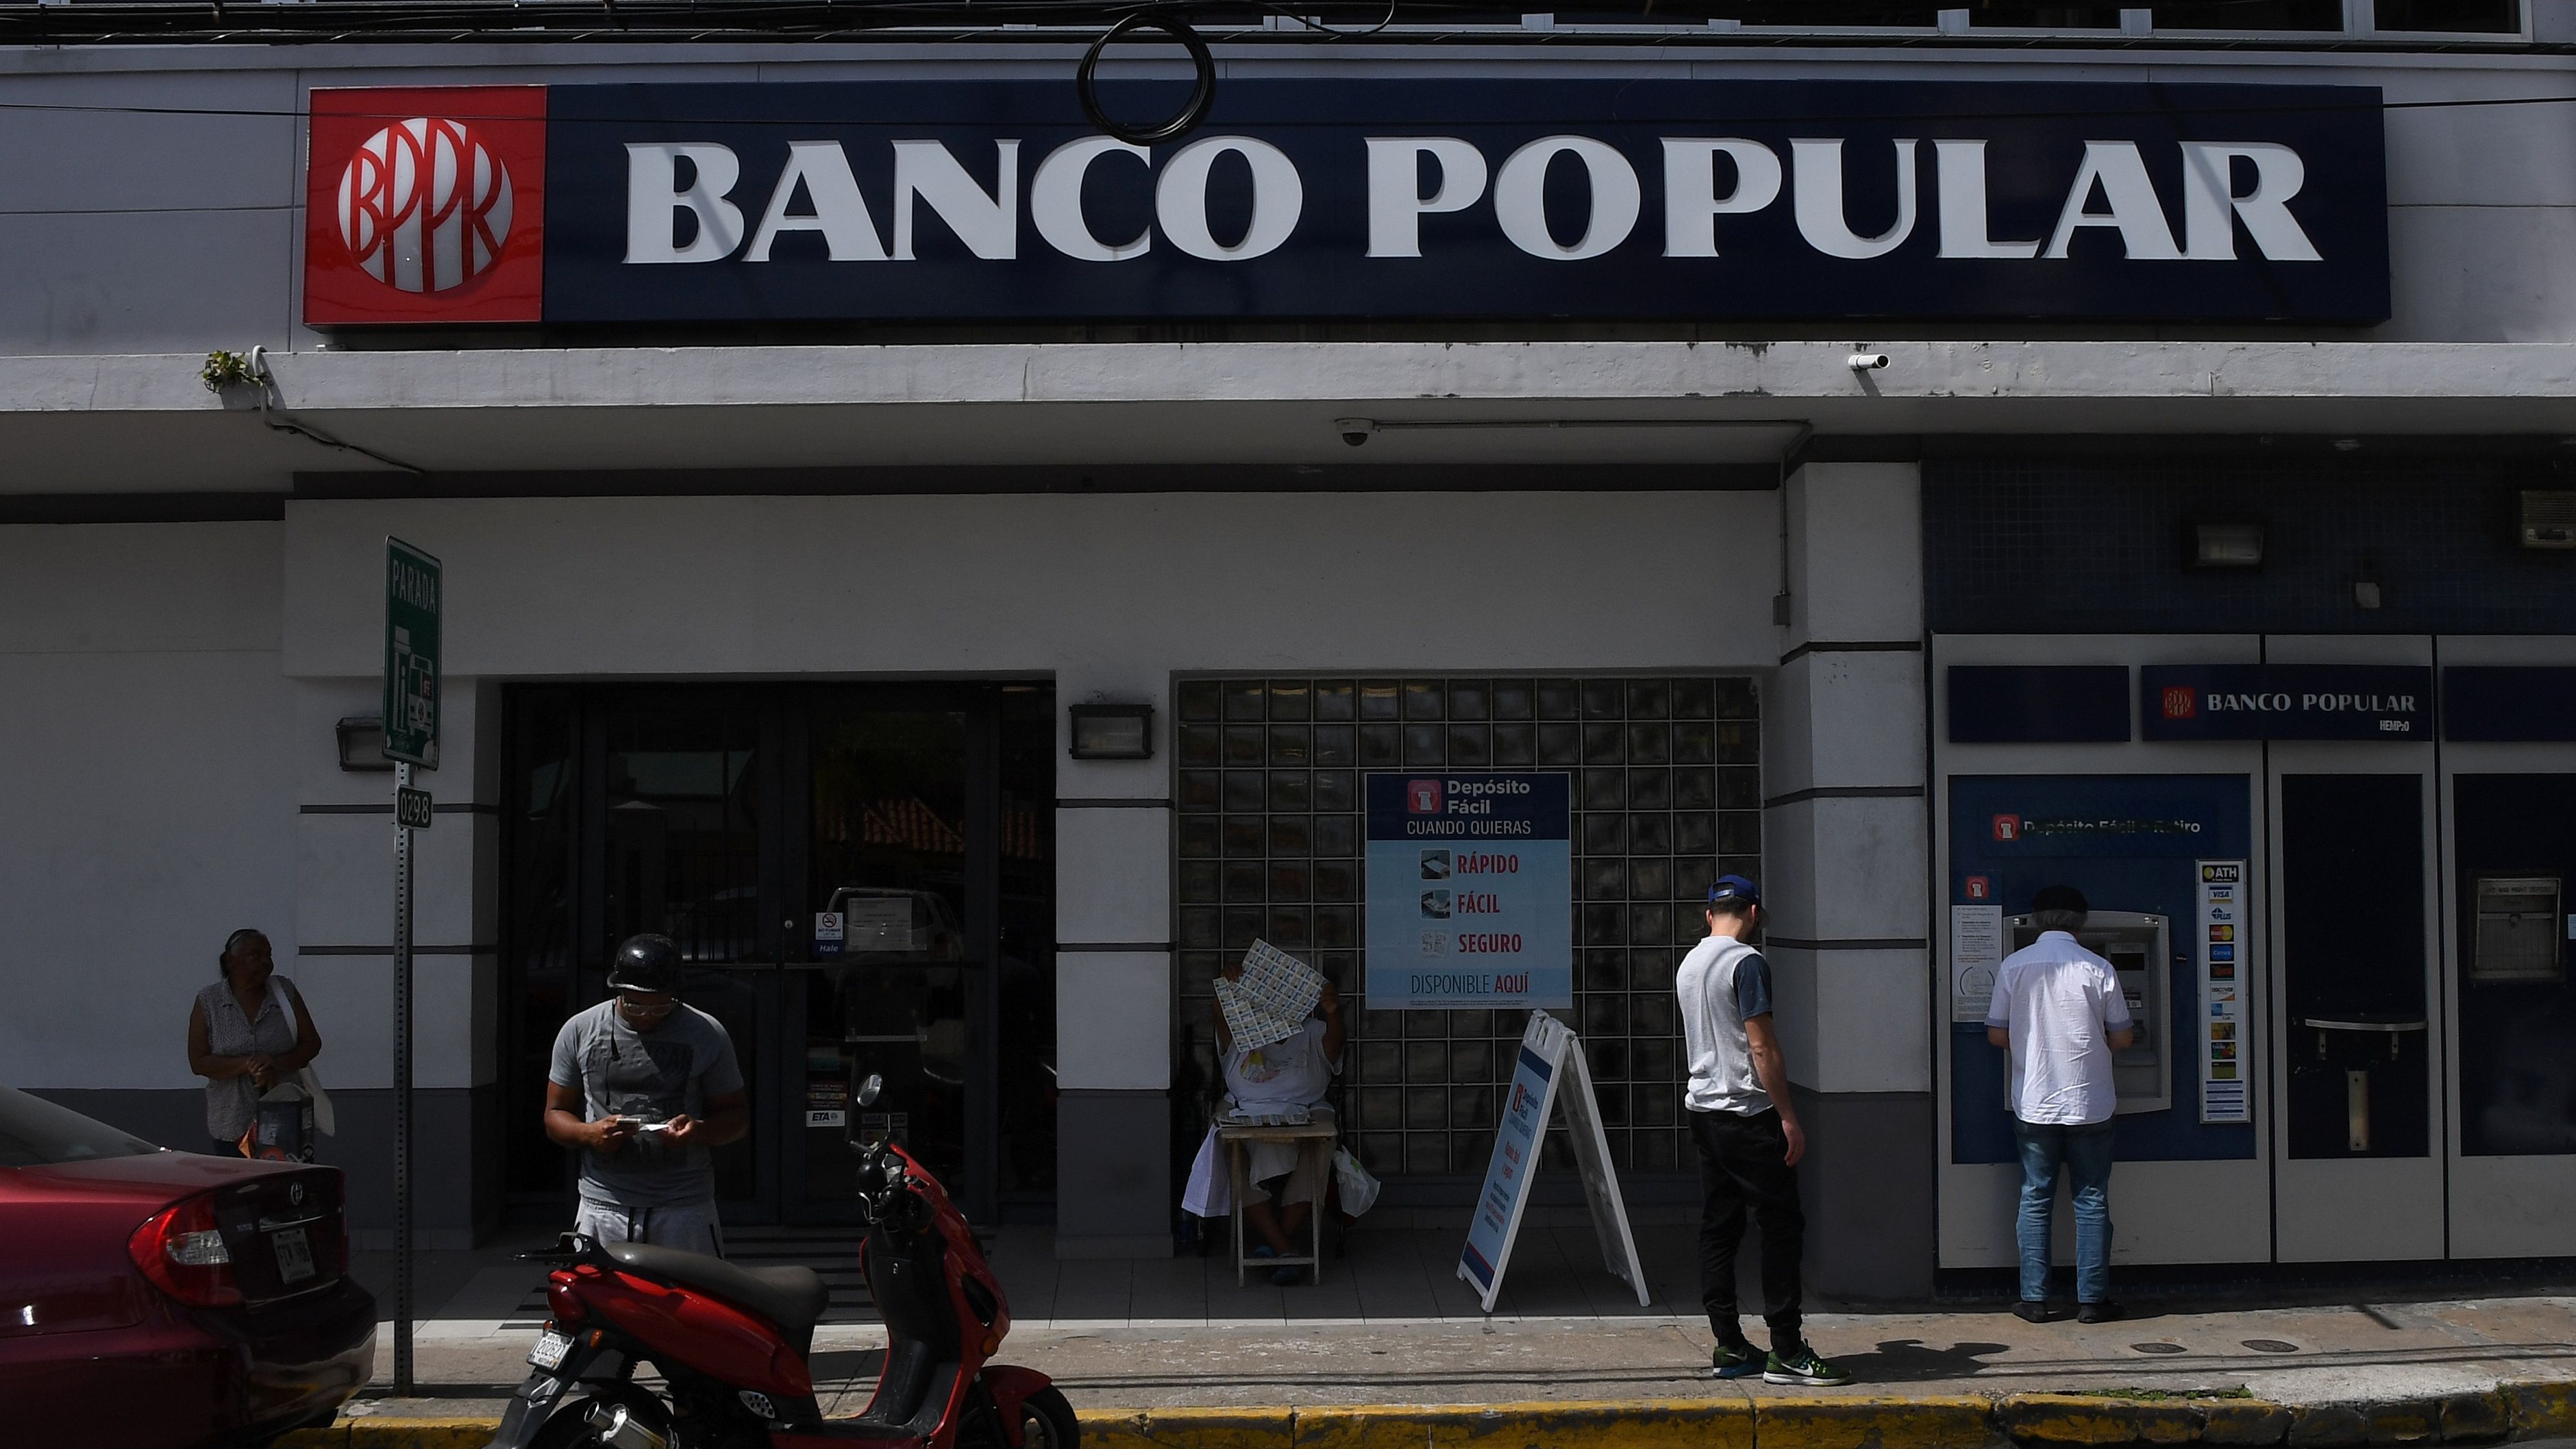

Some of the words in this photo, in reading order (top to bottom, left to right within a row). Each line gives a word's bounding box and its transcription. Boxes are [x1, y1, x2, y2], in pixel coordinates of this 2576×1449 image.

[620, 134, 1304, 264] BANCO
[1363, 134, 2325, 261] POPULAR
[393, 558, 437, 615] PARADA
[2207, 692, 2292, 712] BANCO
[2302, 693, 2416, 713] POPULAR
[1447, 779, 1531, 797] Depósito
[400, 792, 430, 823] 0298
[1447, 798, 1491, 815] Fácil
[1407, 821, 1465, 835] CUANDO
[1470, 820, 1531, 836] QUIERAS
[1457, 851, 1520, 874] RÁPIDO
[2215, 867, 2238, 878] ATH
[1457, 891, 1500, 913] FÁCIL
[1458, 933, 1522, 953] SEGURO
[1411, 974, 1489, 993] DISPONIBLE
[1494, 971, 1529, 993] AQUÍ
[812, 1112, 830, 1122] ETA
